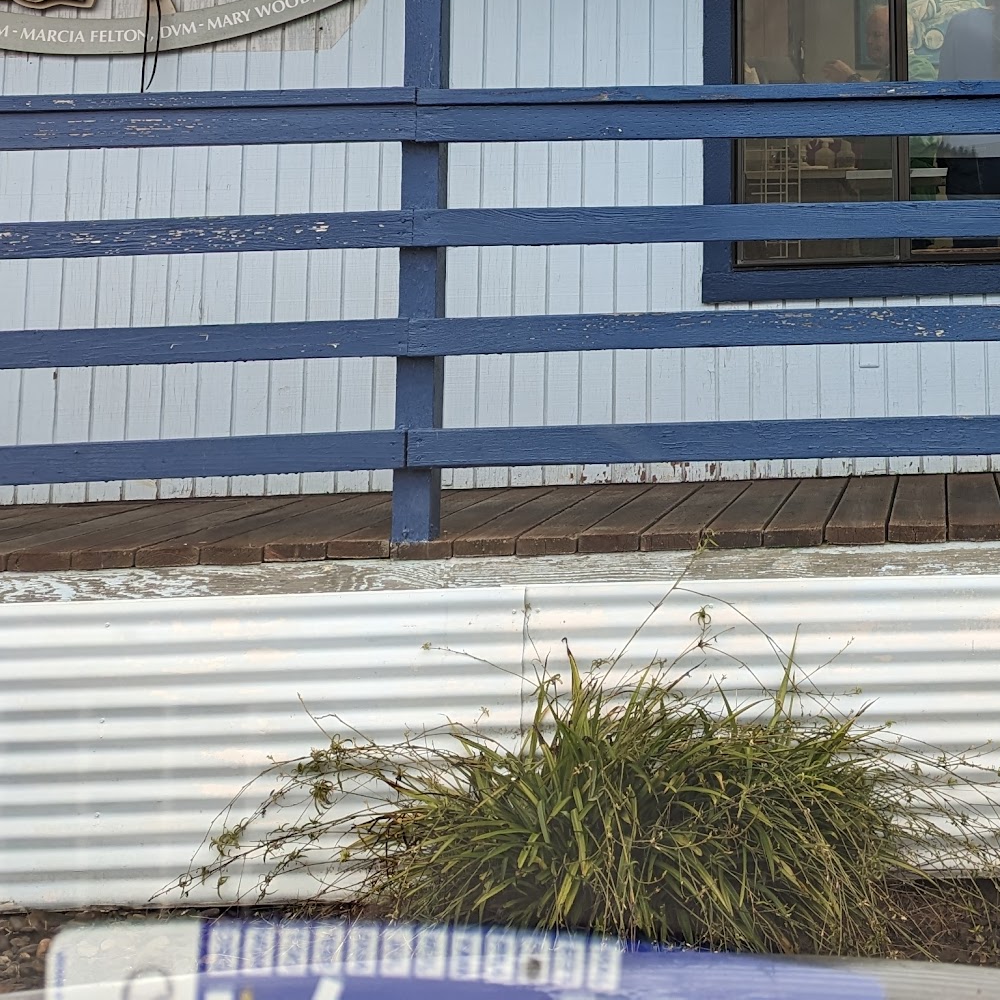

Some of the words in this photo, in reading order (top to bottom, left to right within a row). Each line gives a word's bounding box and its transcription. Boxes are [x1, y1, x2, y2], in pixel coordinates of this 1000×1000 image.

[20, 27, 85, 43] MARCIA
[160, 21, 197, 39] DVM
[207, 9, 251, 31] MARY
